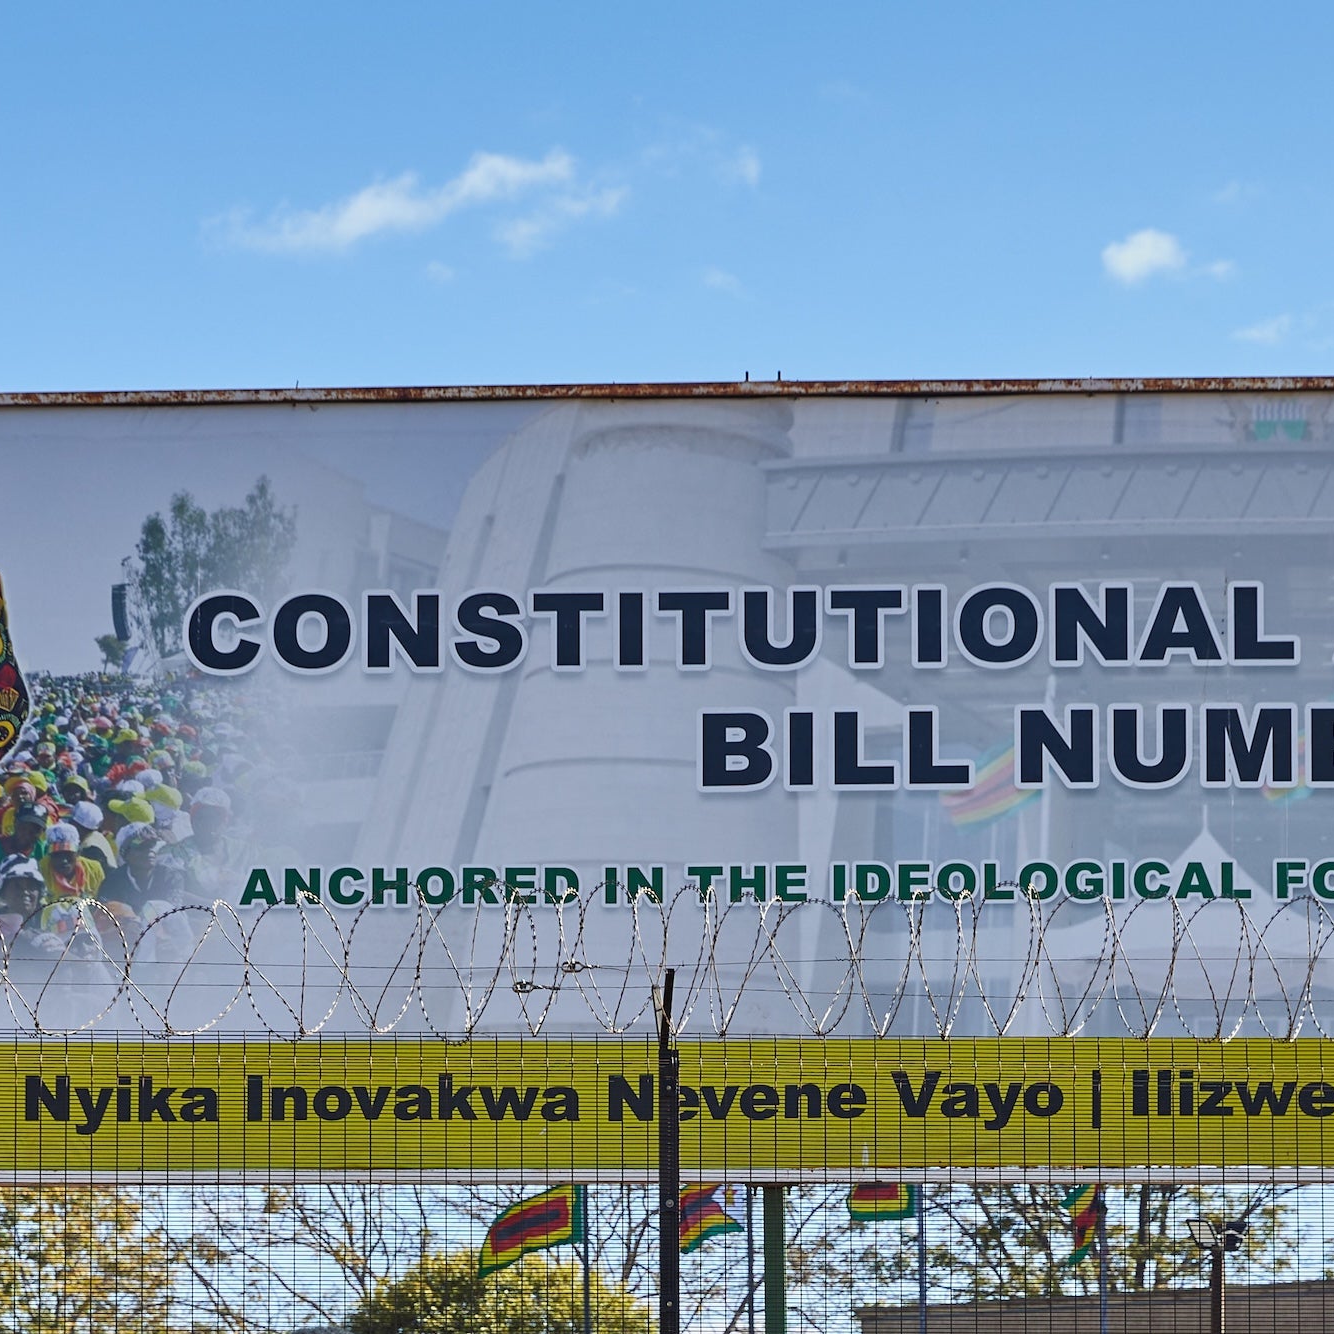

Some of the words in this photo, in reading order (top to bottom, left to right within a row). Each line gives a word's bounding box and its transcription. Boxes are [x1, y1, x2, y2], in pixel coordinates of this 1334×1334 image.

[188, 585, 1295, 671] CONSTITUTIONAL
[701, 704, 971, 788] BILL
[239, 866, 579, 906] ANCHORED
[605, 865, 663, 904] IN
[687, 864, 808, 903] THE
[832, 860, 1253, 902] IDEOLOGICAL
[24, 1075, 219, 1135] Nyika
[246, 1073, 579, 1122] Inovakwa
[608, 1074, 867, 1122] Nevene
[891, 1070, 1064, 1130] Vayo
